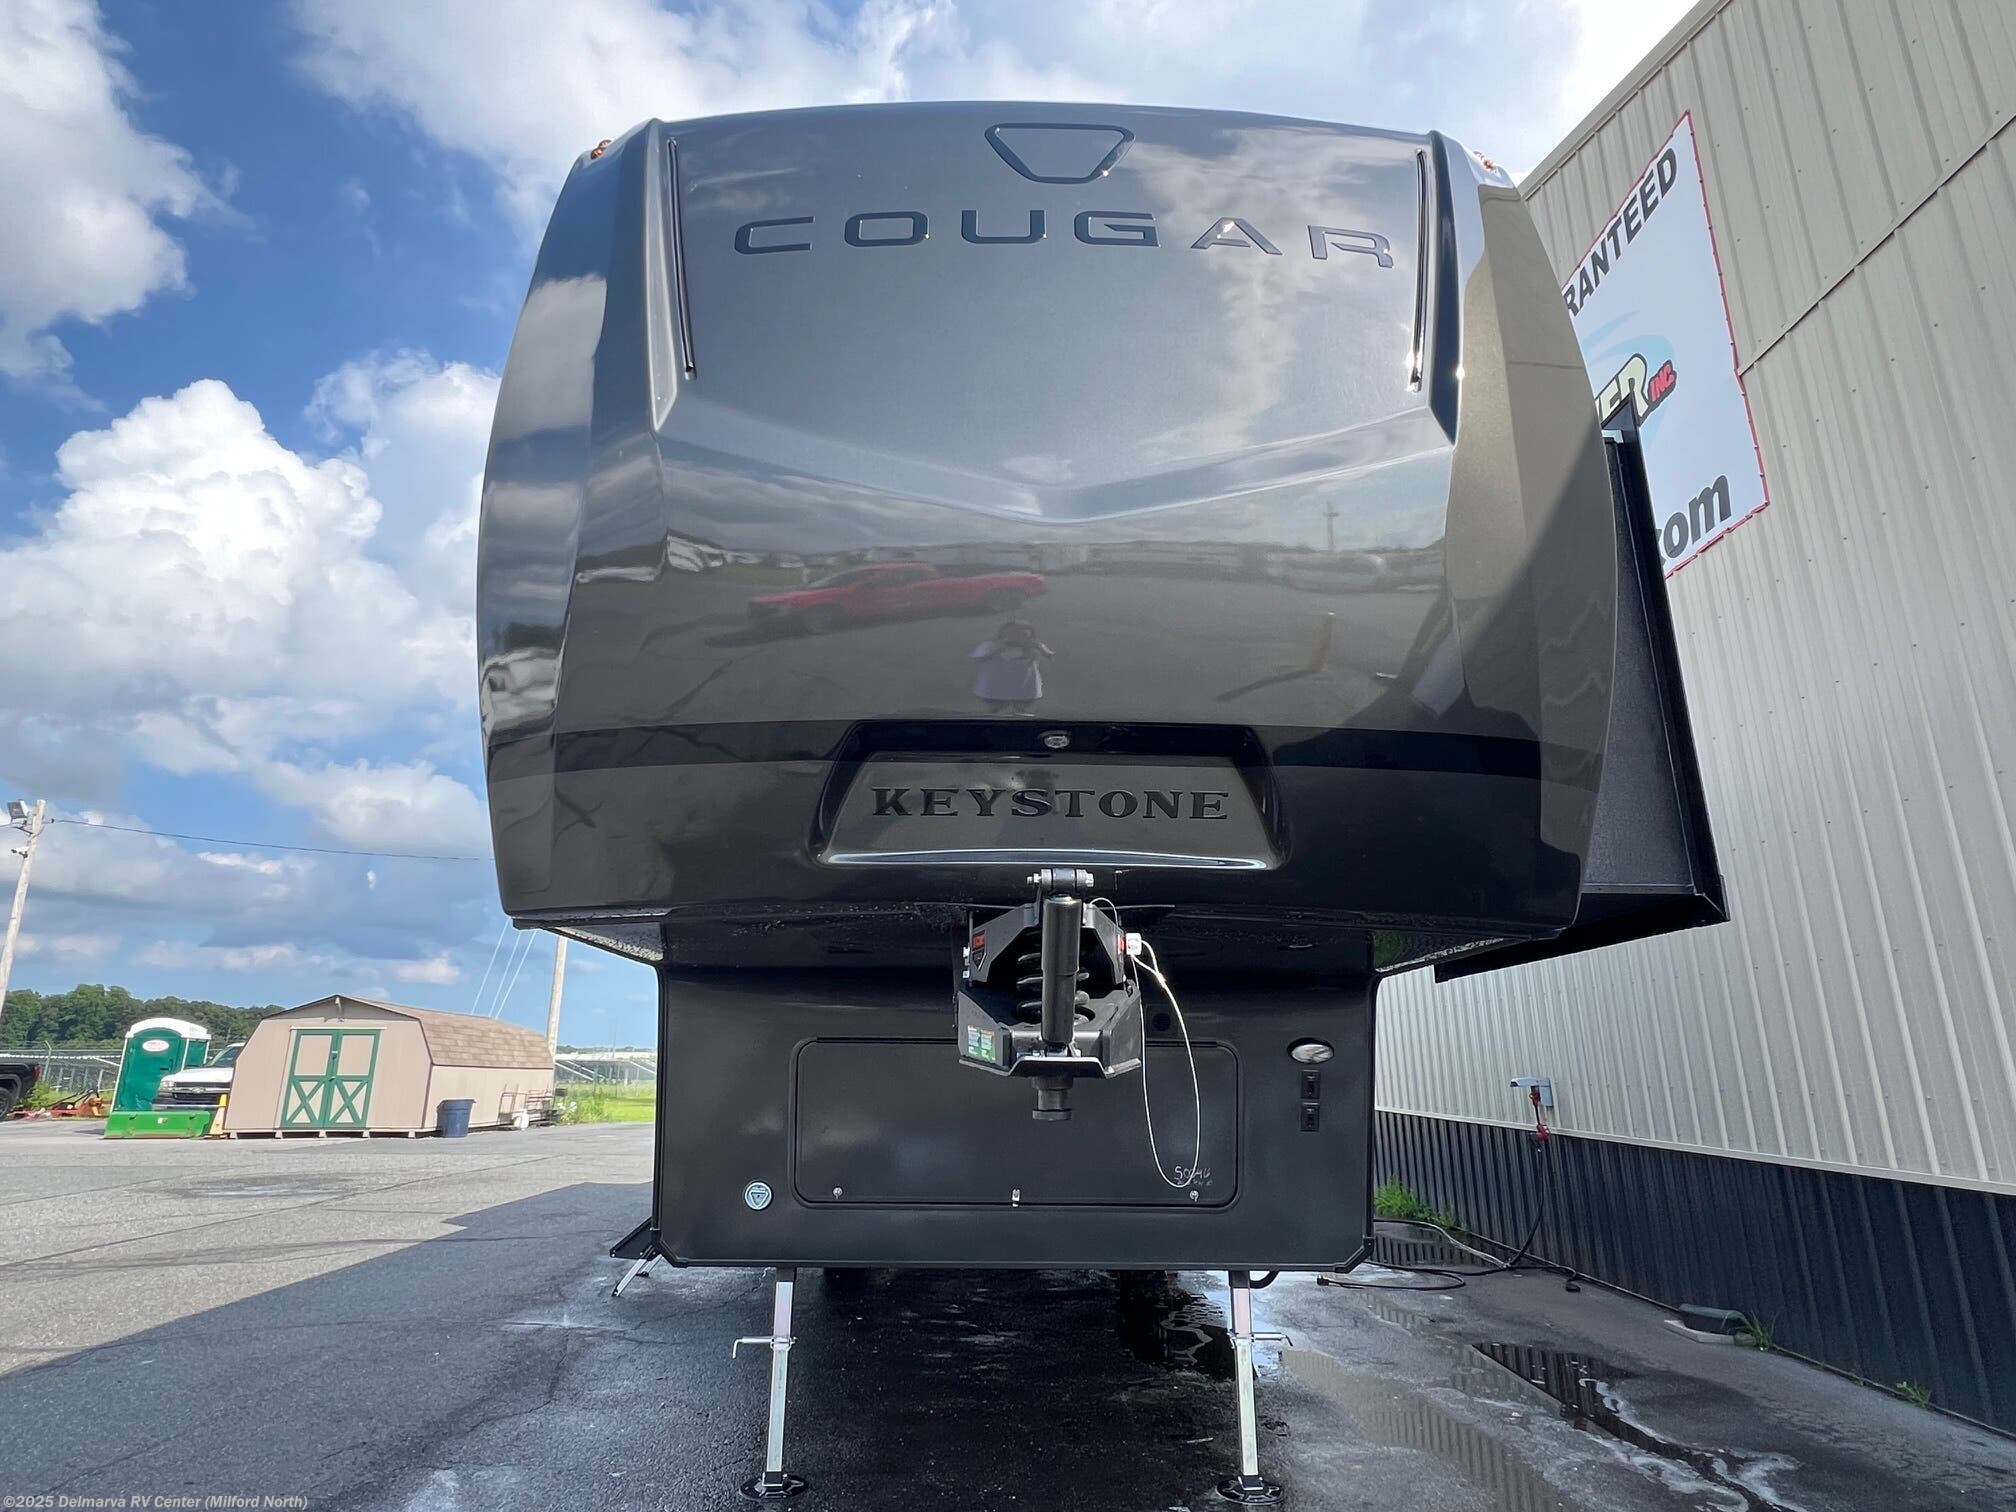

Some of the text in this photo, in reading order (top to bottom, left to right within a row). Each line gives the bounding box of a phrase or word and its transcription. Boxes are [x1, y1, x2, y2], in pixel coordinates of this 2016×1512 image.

[734, 208, 1394, 269] COUGAR
[1595, 353, 1649, 424] ER
[1656, 475, 1731, 562] om
[871, 787, 1228, 820] KEYSTONE
